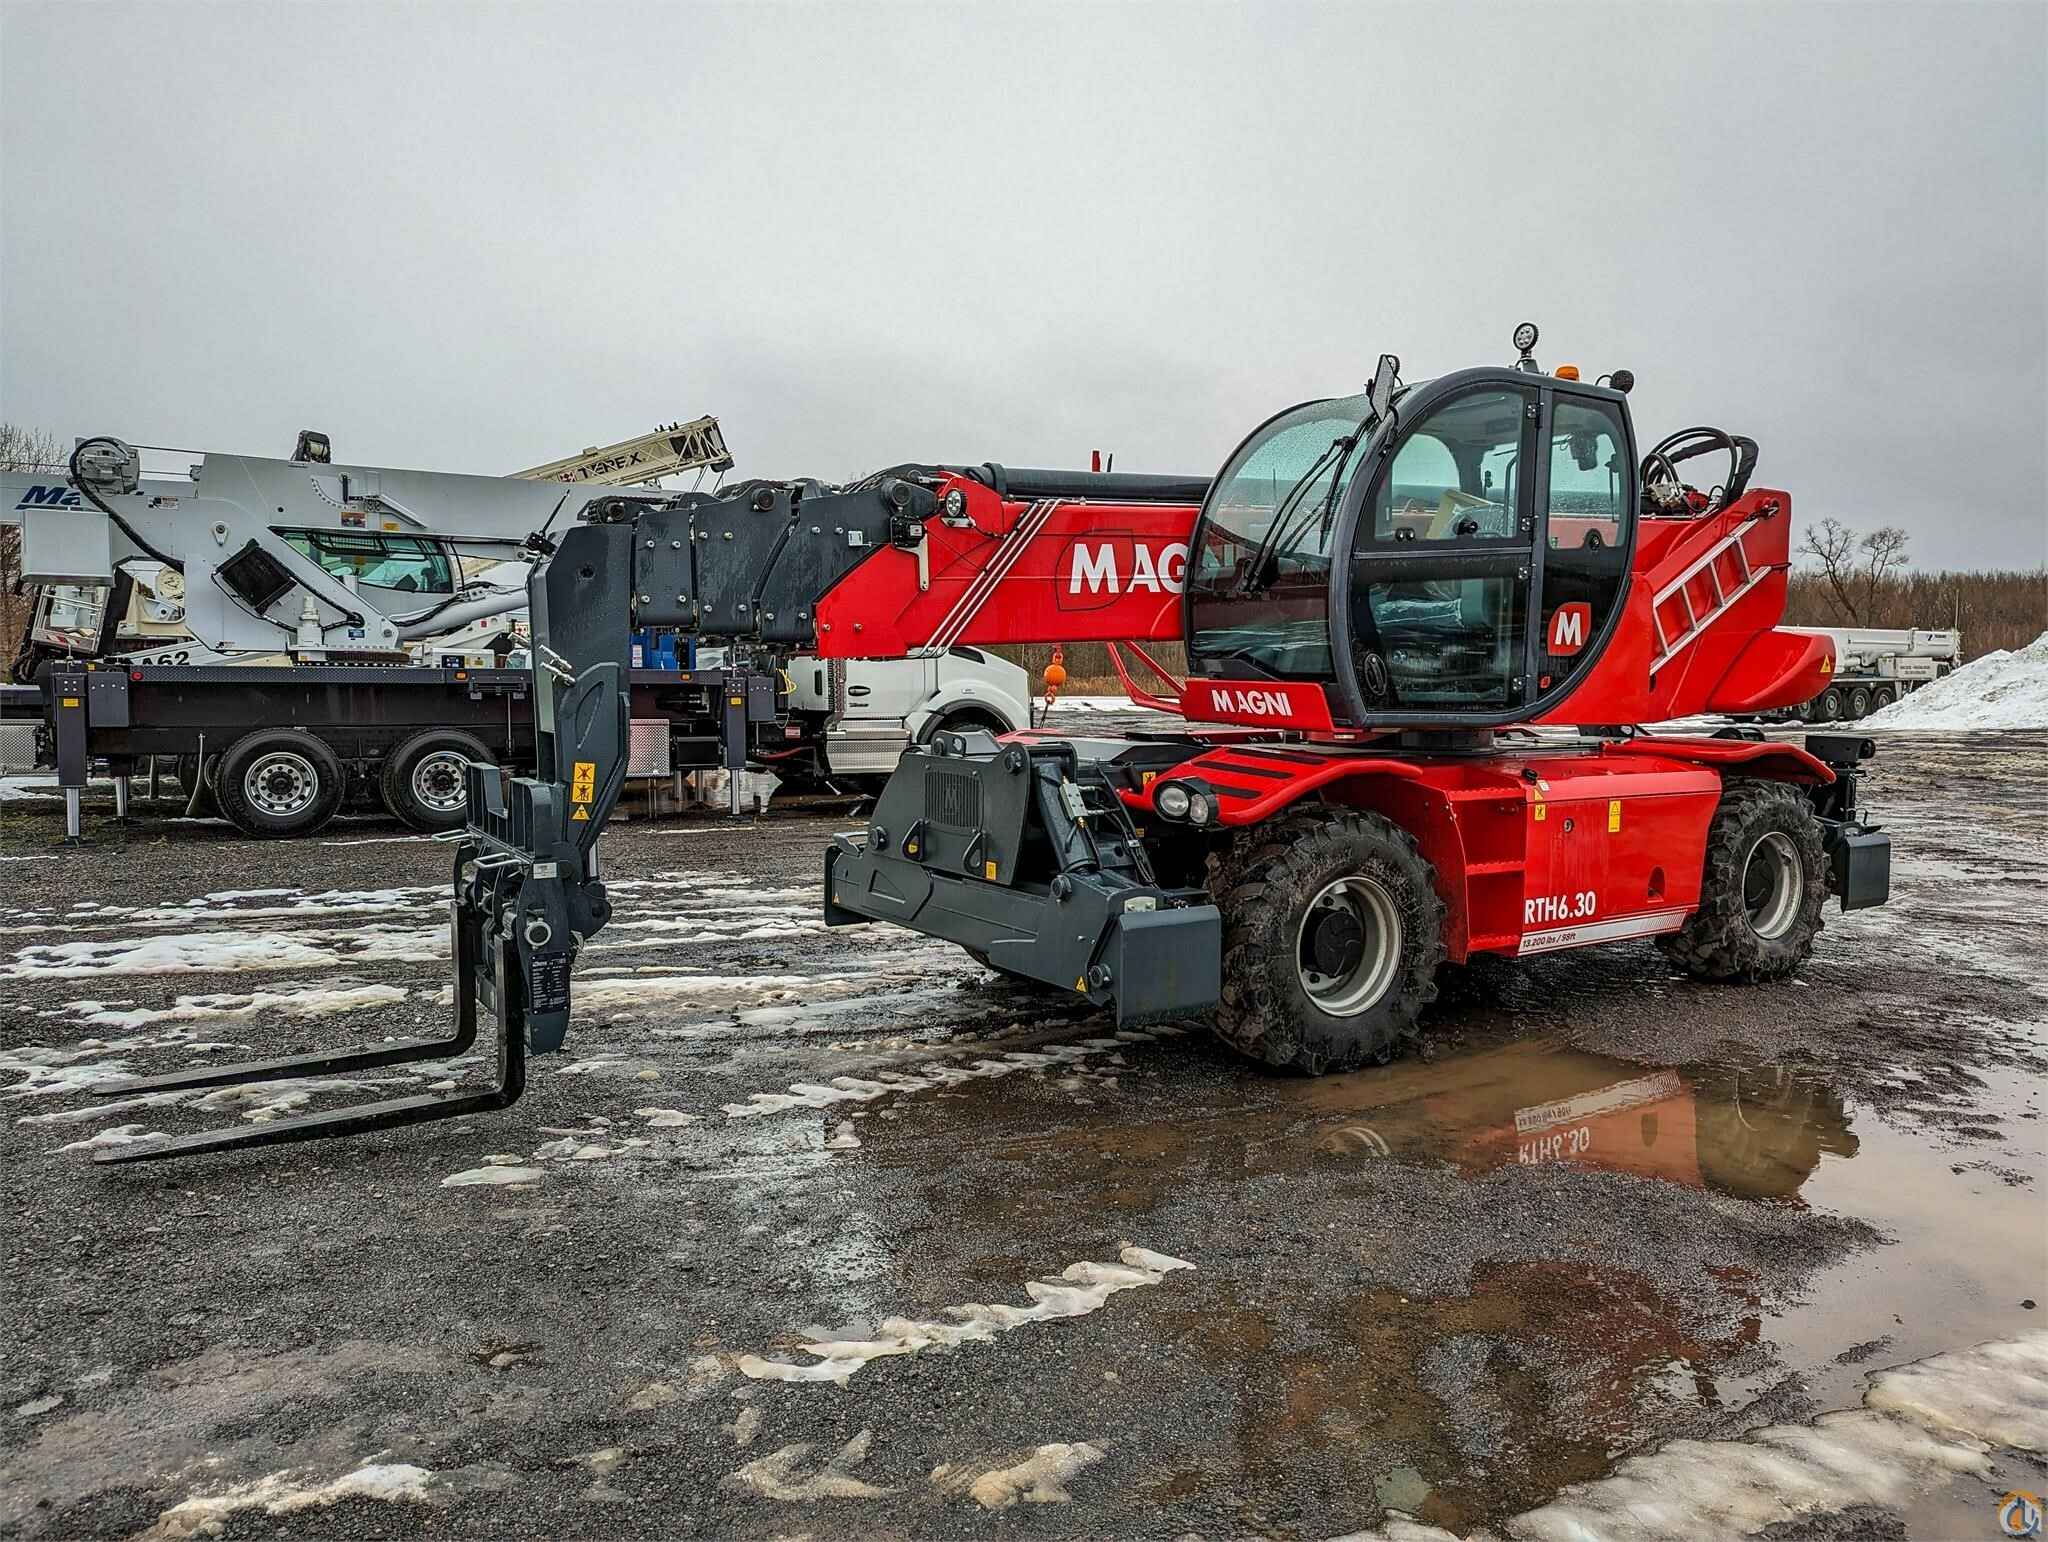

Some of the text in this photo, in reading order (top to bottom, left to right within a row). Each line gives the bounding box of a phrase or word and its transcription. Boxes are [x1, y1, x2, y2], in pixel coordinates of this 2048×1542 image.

[577, 451, 643, 479] TEREX
[1554, 611, 1582, 646] M
[1211, 689, 1293, 717] MAGNI
[1524, 891, 1596, 924] RTH6.30
